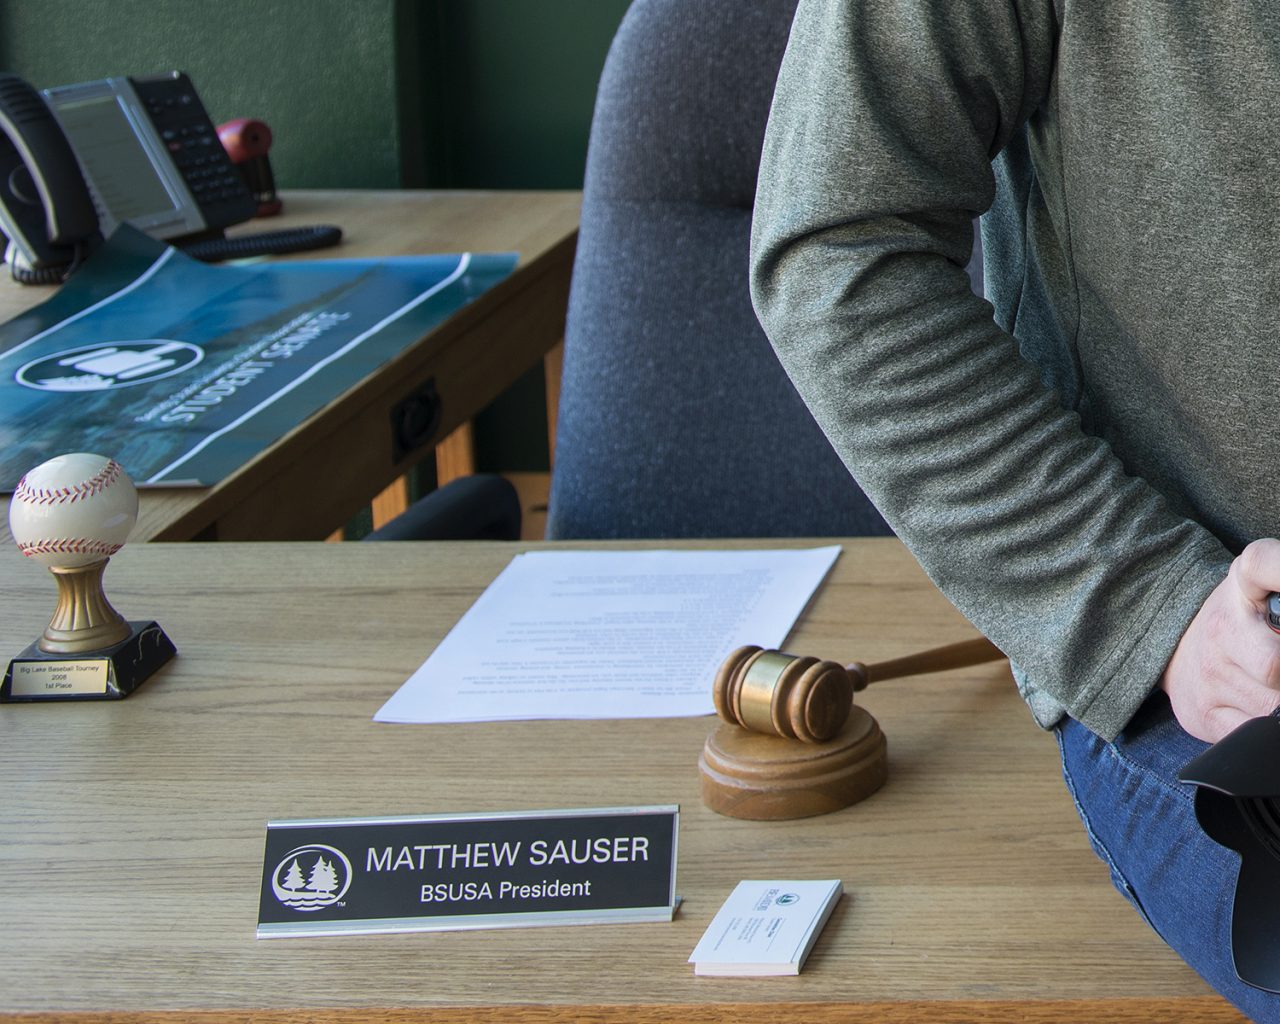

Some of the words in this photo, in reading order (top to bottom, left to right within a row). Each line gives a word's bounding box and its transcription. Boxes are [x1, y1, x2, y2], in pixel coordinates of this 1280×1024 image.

[160, 361, 275, 423] STUDENT
[261, 311, 351, 359] SENATE
[20, 666, 31, 674] Big
[48, 665, 74, 673] Baseball
[75, 665, 100, 674] Tourney
[366, 841, 521, 872] MATTHEW
[529, 836, 650, 866] SAUSER
[420, 882, 493, 903] BSUSA
[499, 879, 592, 899] President
